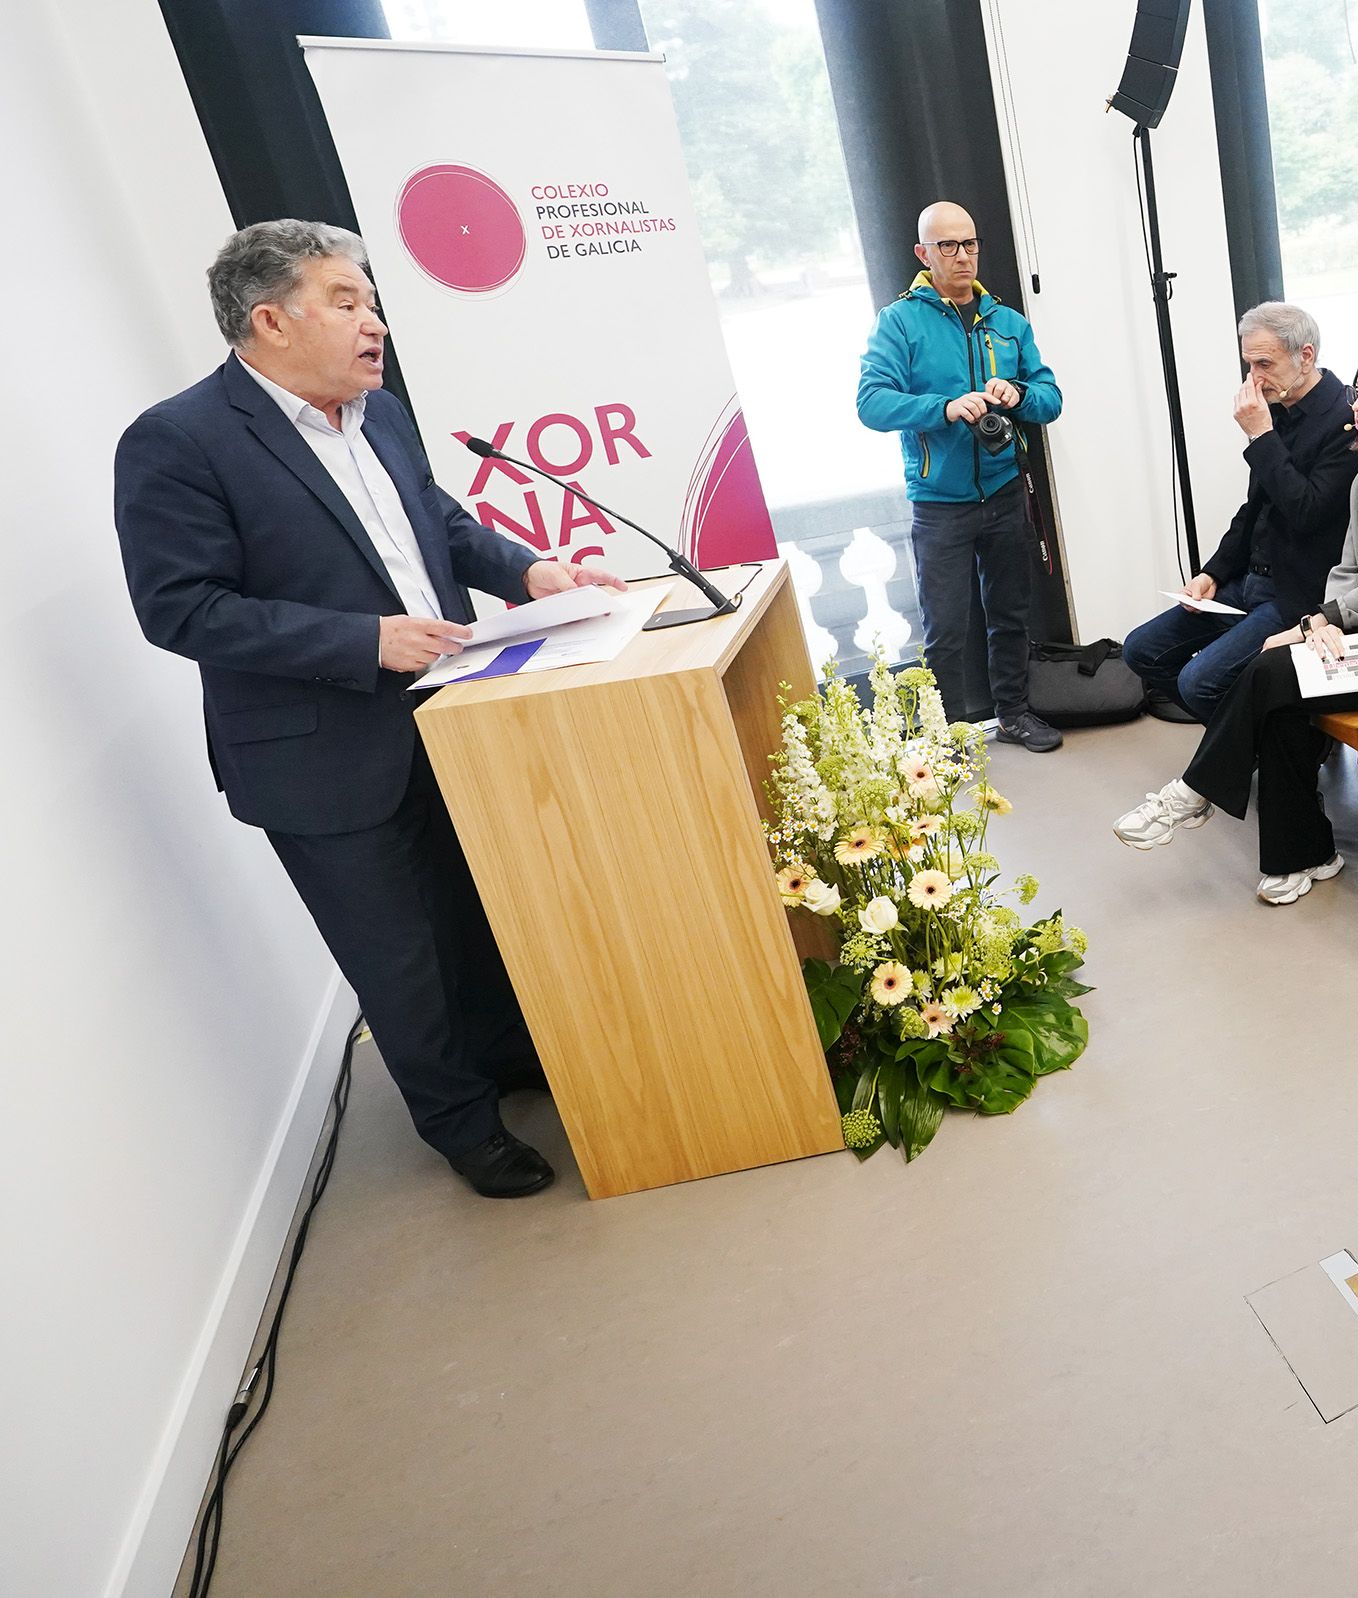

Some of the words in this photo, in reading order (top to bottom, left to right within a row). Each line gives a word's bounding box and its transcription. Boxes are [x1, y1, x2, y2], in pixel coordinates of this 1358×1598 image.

[531, 183, 609, 200] COLEXIO
[536, 201, 650, 220] PROFESIONAL
[541, 225, 566, 240] DE
[569, 218, 676, 238] XORNALISTAS
[547, 244, 571, 259] DE
[575, 239, 642, 257] GALICIA
[450, 403, 653, 497] XOR
[475, 481, 617, 552] NA
